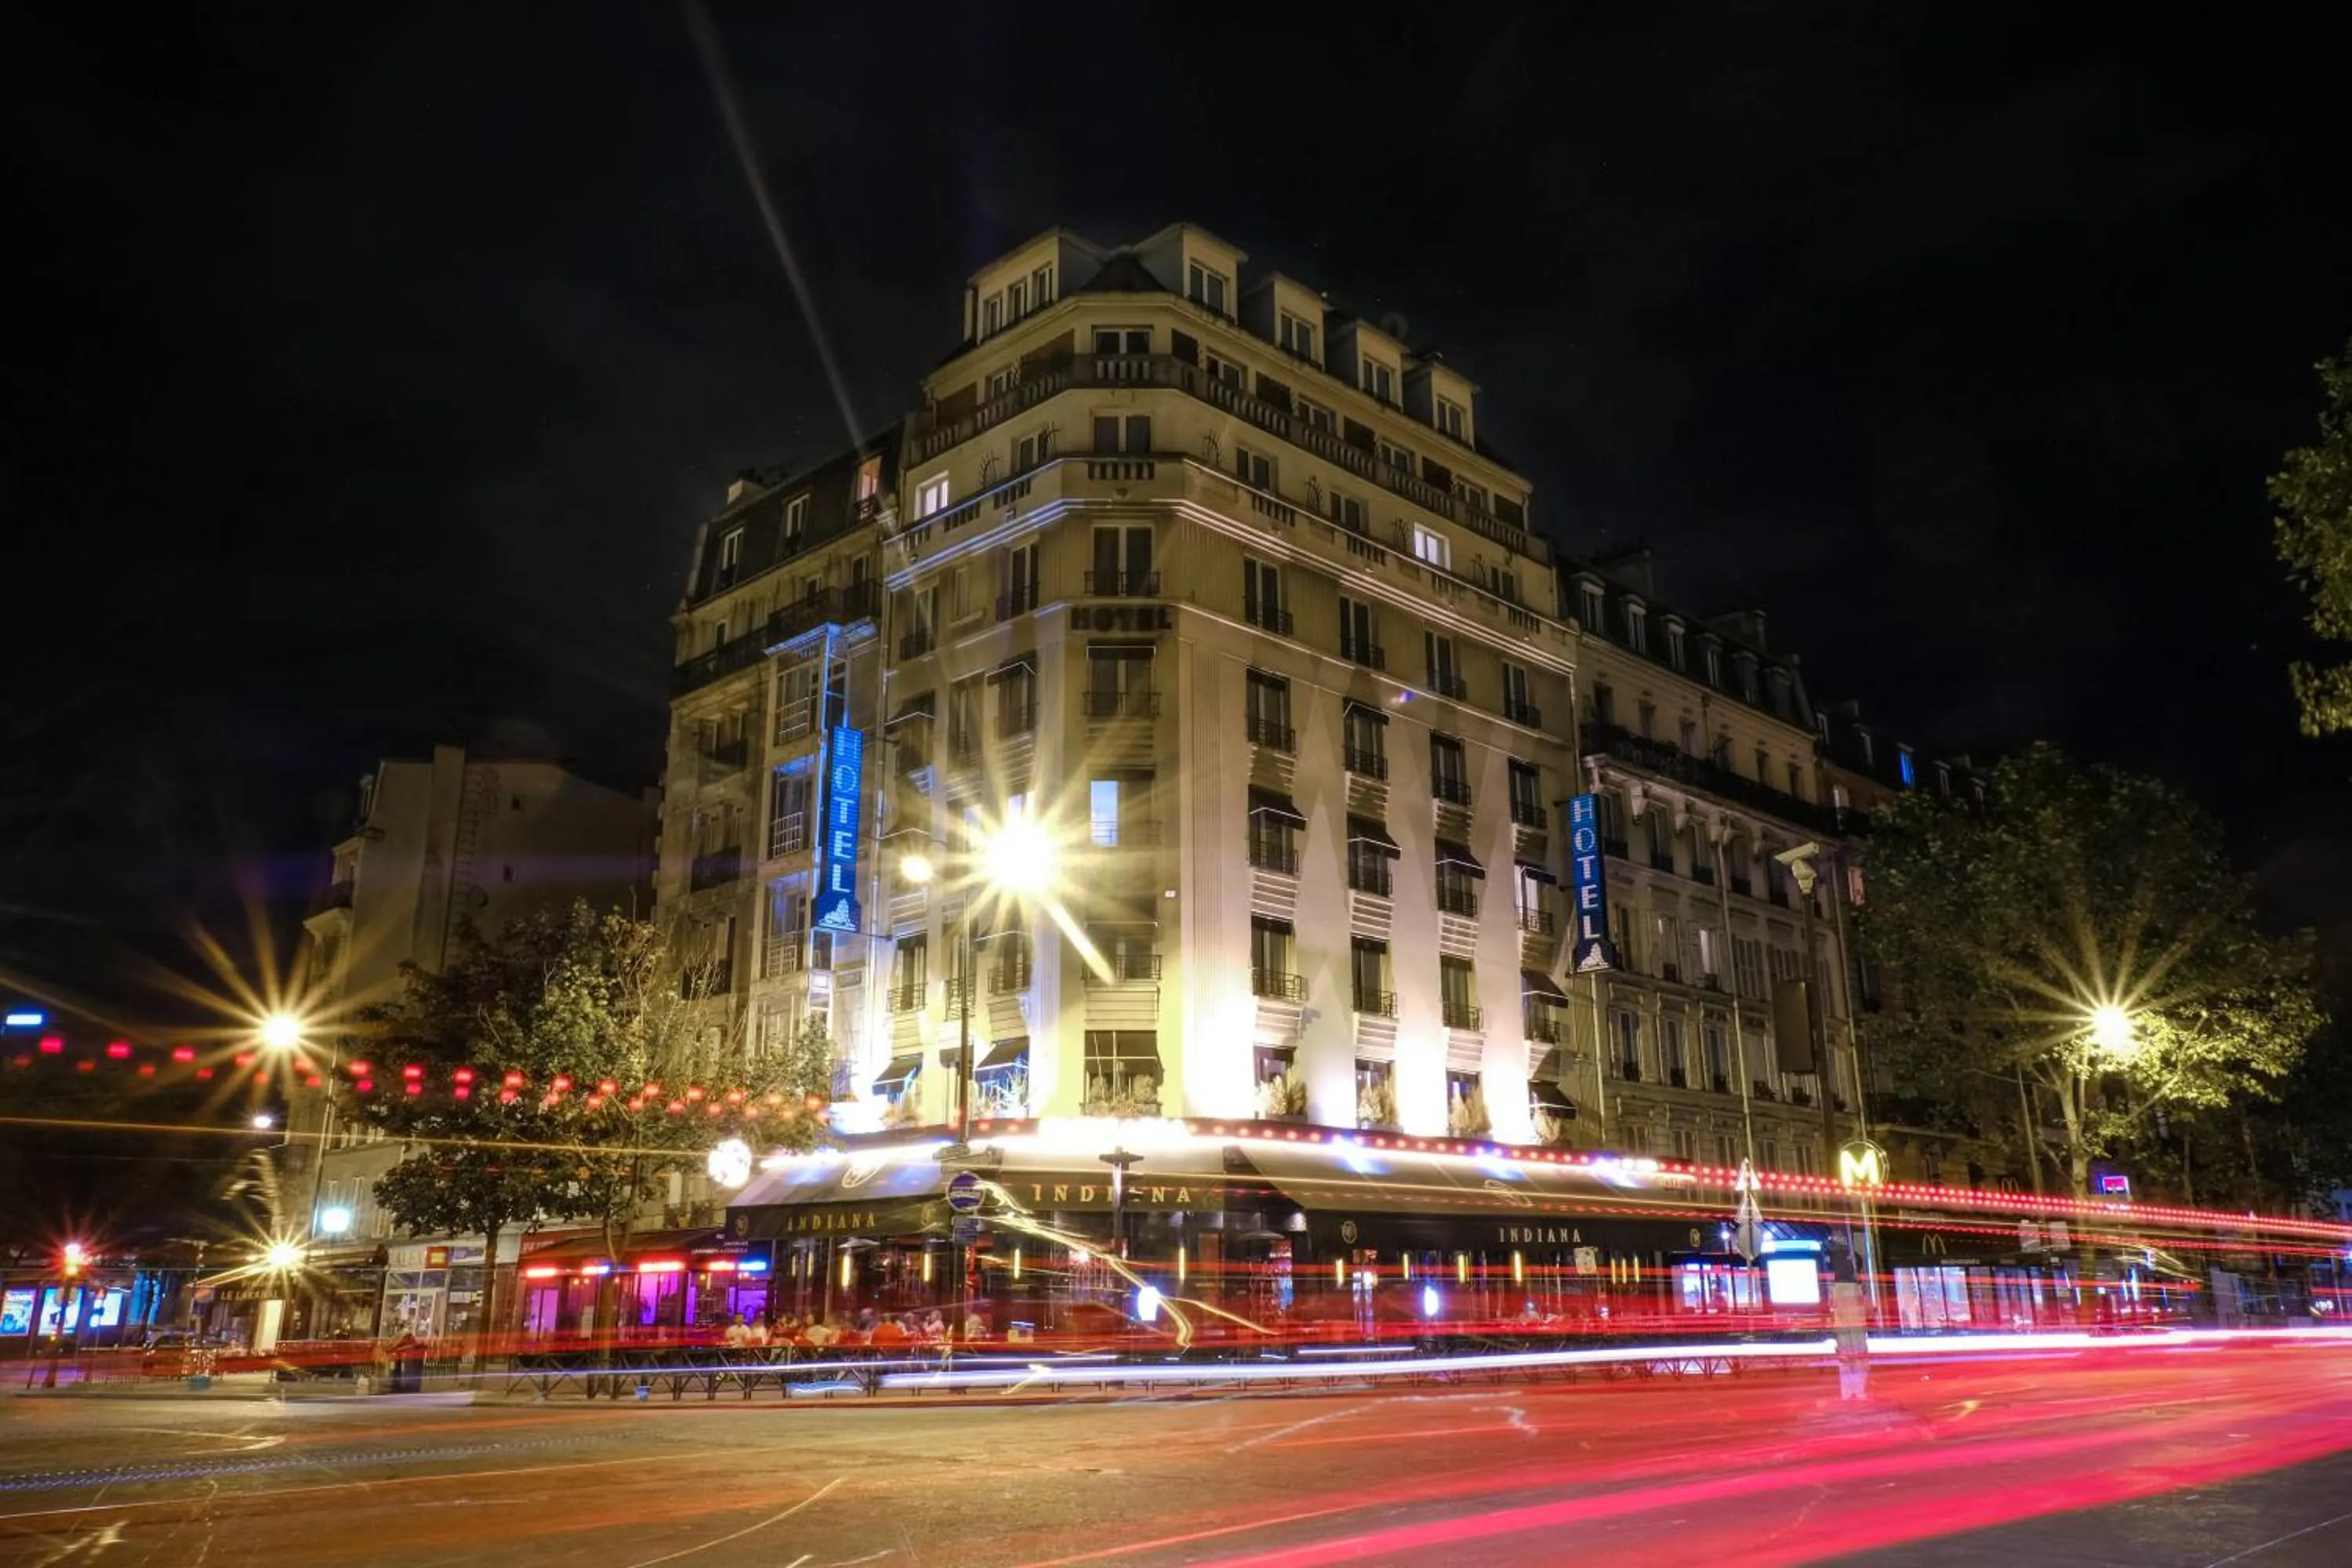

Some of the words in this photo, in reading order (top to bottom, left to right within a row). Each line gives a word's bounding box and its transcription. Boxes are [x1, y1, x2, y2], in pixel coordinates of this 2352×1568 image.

[832, 731, 859, 894] HOTEL
[1573, 797, 1600, 939] HOTEL
[1840, 1149, 1879, 1188] M
[787, 1211, 875, 1232] INDIANA
[1498, 1227, 1581, 1243] INDIANA
